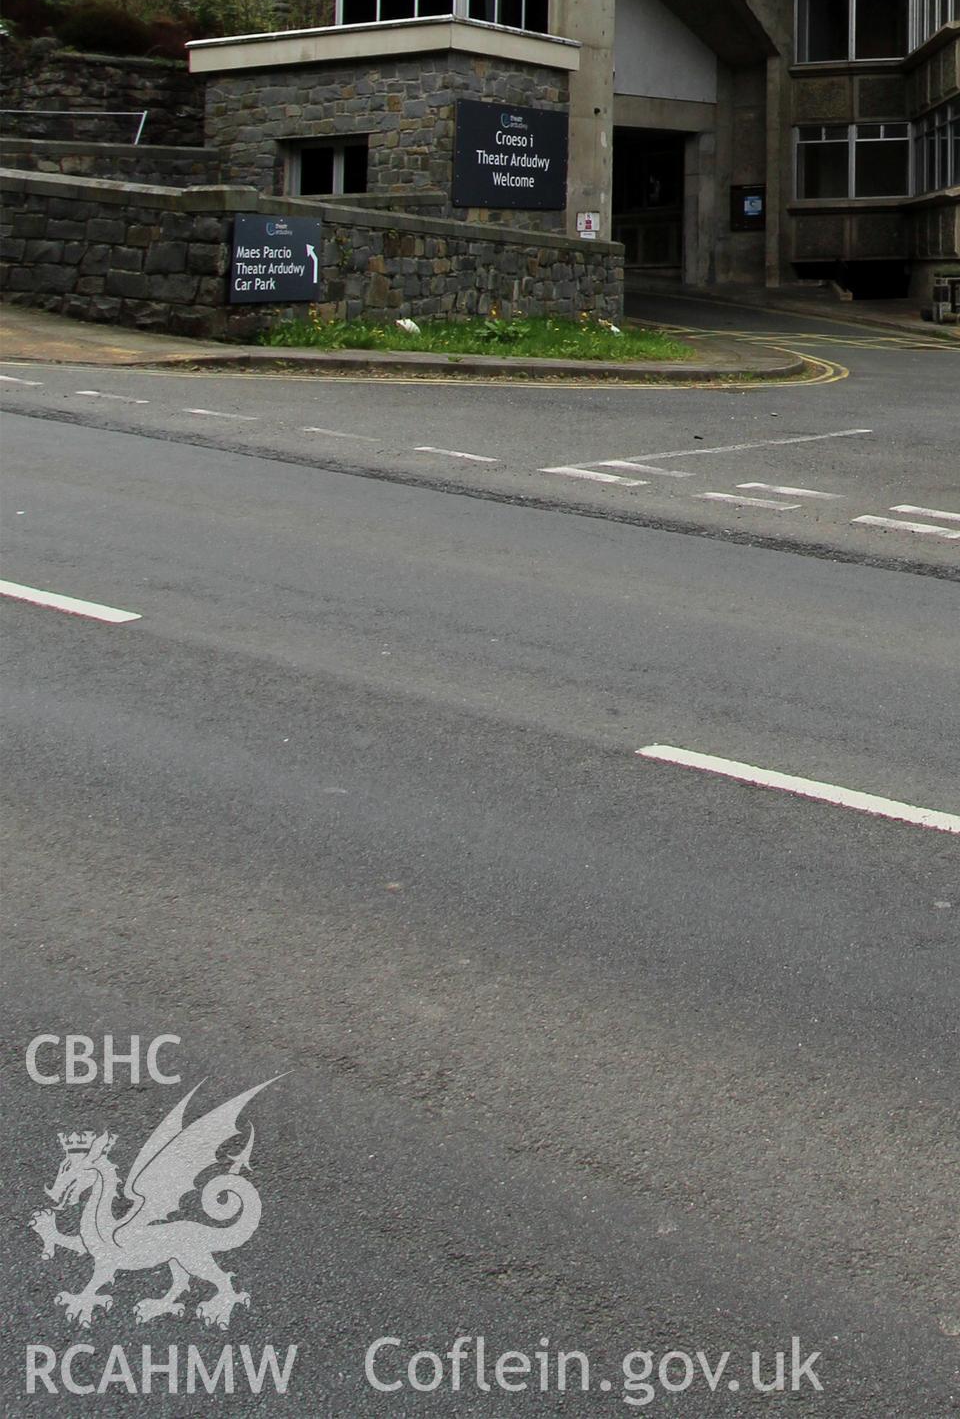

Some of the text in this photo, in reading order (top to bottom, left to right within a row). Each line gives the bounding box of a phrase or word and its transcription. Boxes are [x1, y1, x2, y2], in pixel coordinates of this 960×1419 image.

[495, 130, 534, 148] Croeso i
[476, 149, 550, 172] Theatr Ardudwy
[492, 171, 535, 188] Welcome
[236, 246, 292, 259] Maes Parcio
[236, 262, 305, 277] Theatr Ardudwy
[234, 277, 276, 291] Car Park
